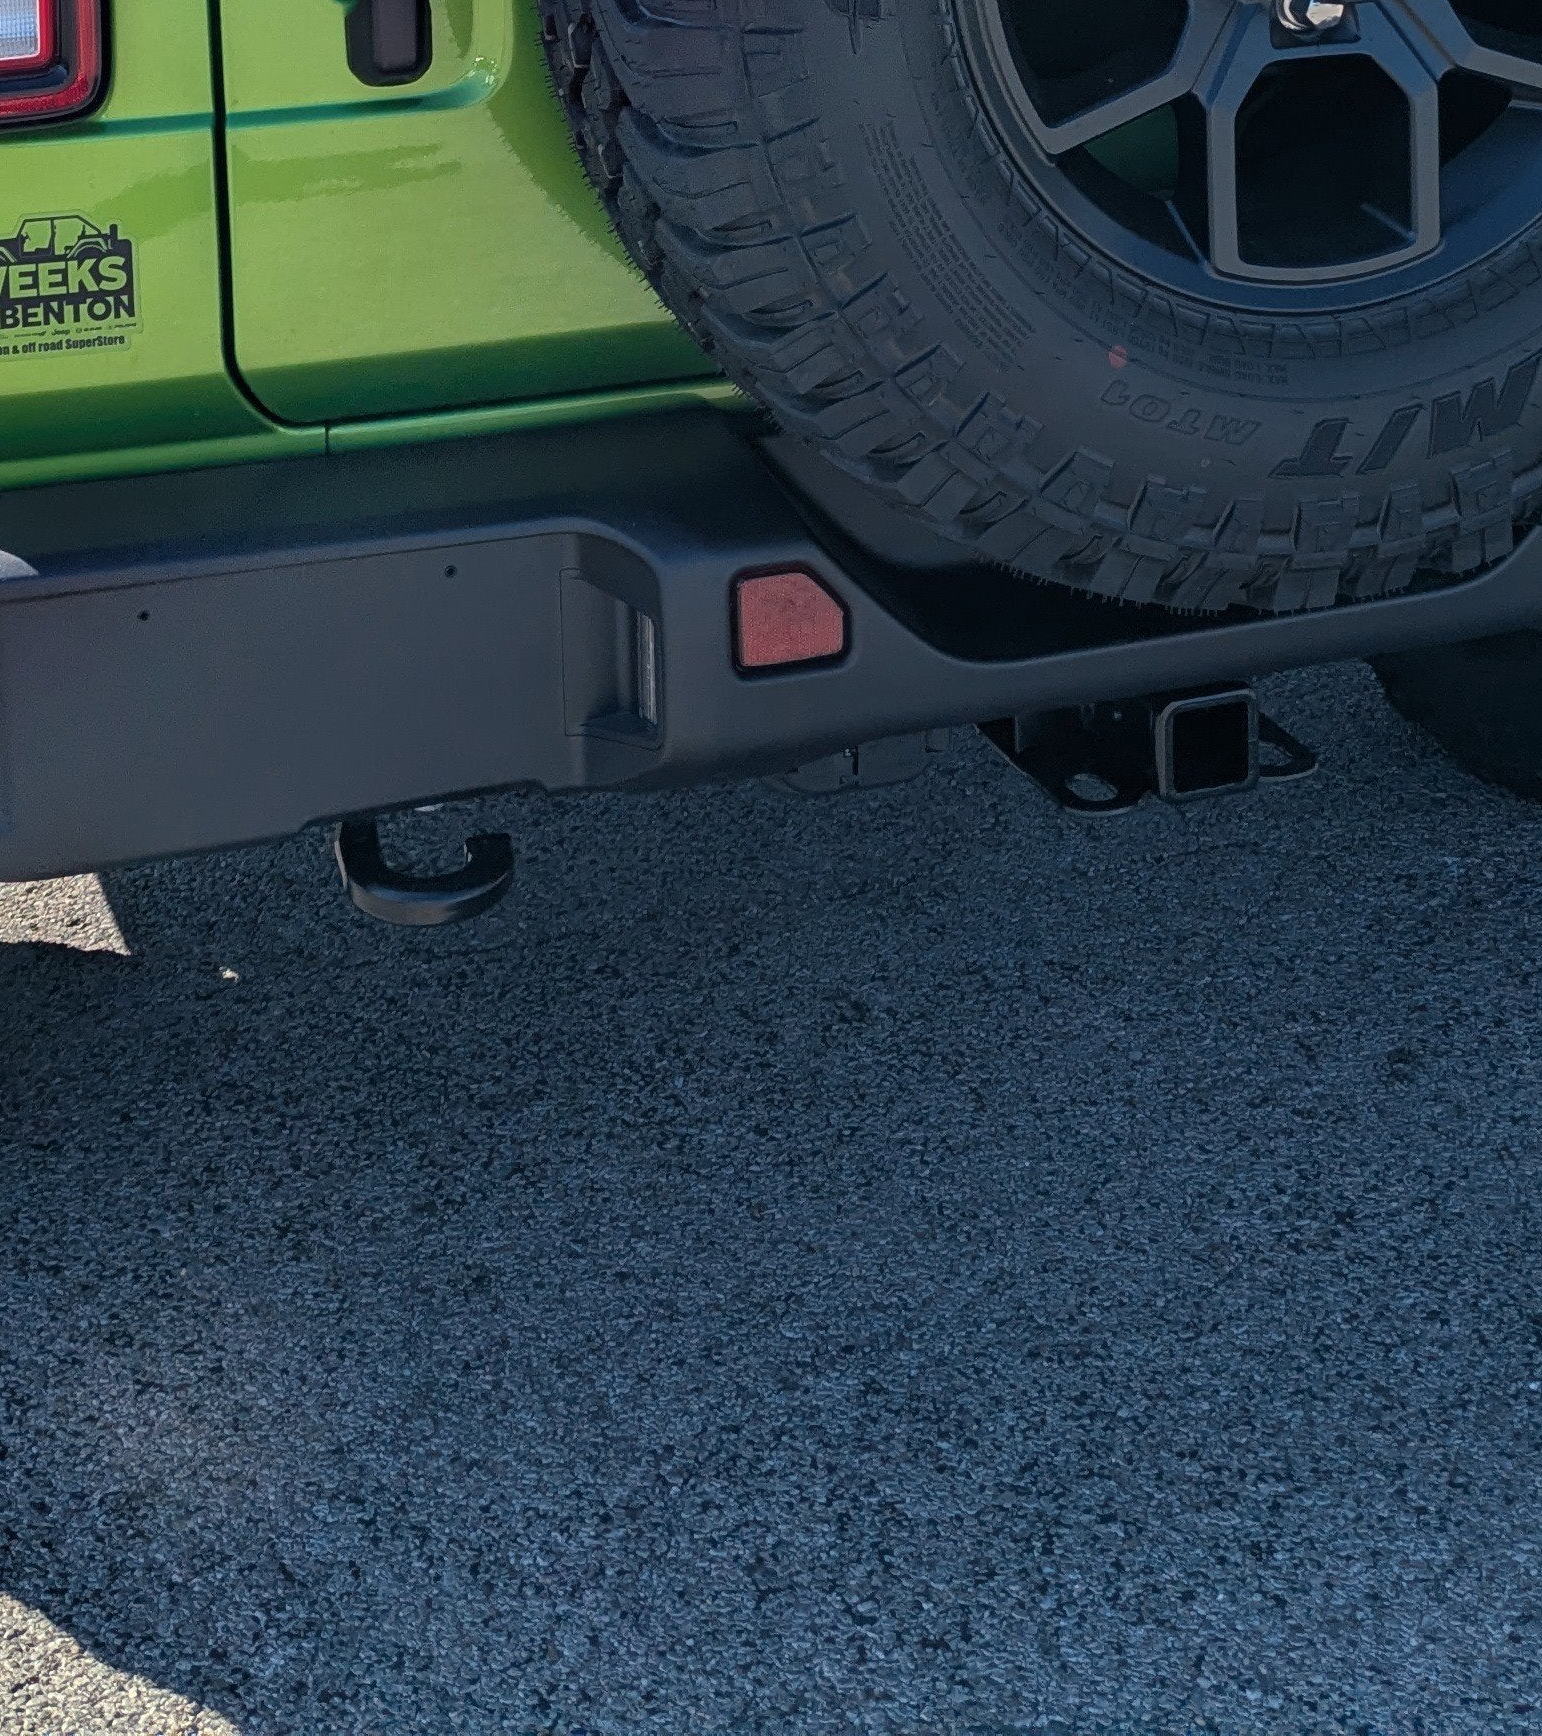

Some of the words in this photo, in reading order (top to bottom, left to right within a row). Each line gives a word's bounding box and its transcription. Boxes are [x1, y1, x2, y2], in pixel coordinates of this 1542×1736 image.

[0, 294, 136, 330] BENTON
[12, 344, 20, 354] &
[22, 342, 36, 353] off
[39, 339, 63, 351] road
[65, 335, 125, 349] SuperStore
[1100, 379, 1263, 446] MT01
